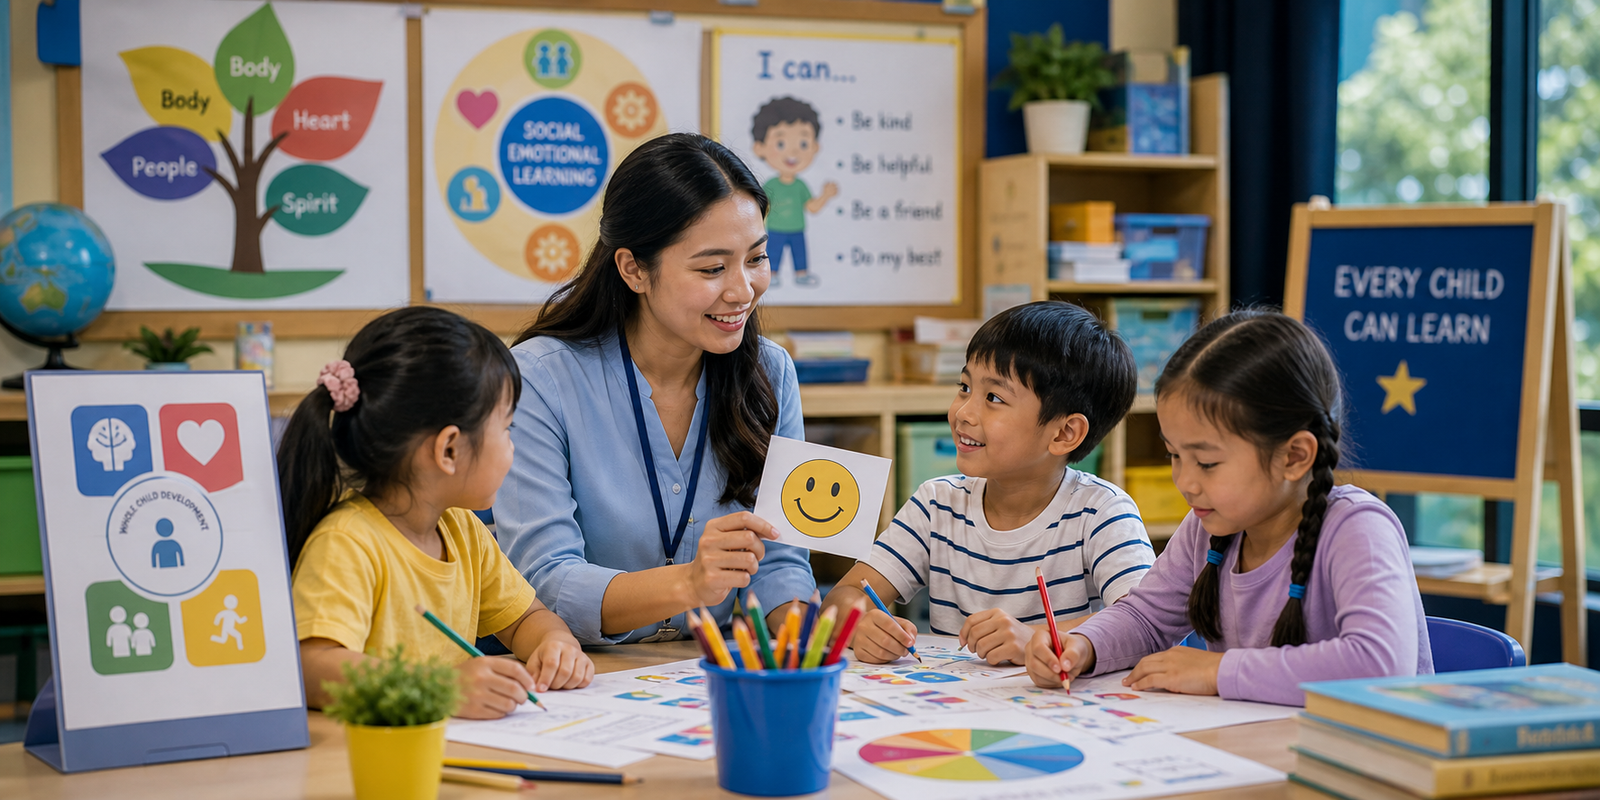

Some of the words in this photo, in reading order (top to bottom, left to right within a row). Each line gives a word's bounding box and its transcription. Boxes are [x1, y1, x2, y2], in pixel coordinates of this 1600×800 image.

[229, 55, 281, 83] Body
[758, 51, 773, 79] I
[161, 89, 210, 115] Body
[293, 109, 350, 131] Heart
[523, 120, 585, 141] SOCIAL
[852, 111, 872, 130] Be
[878, 111, 912, 131] kind
[507, 143, 603, 165] EMOTIONAL
[852, 154, 872, 174] Be
[878, 155, 933, 179] helpful
[132, 156, 198, 182] People
[513, 165, 597, 187] LEARNING
[281, 192, 338, 218] Spirit
[852, 200, 872, 220] Be
[878, 207, 889, 218] a
[895, 202, 943, 220] friend
[852, 246, 873, 266] Do
[877, 252, 902, 272] my
[907, 249, 942, 267] best
[1334, 265, 1422, 299] EVERY
[1429, 267, 1505, 300] CHILD
[1344, 310, 1399, 342] CAN
[1406, 312, 1491, 344] LEARN
[119, 505, 138, 535] WHOLE
[136, 490, 159, 508] CHILD
[161, 490, 209, 531] DEVELOPMENT
